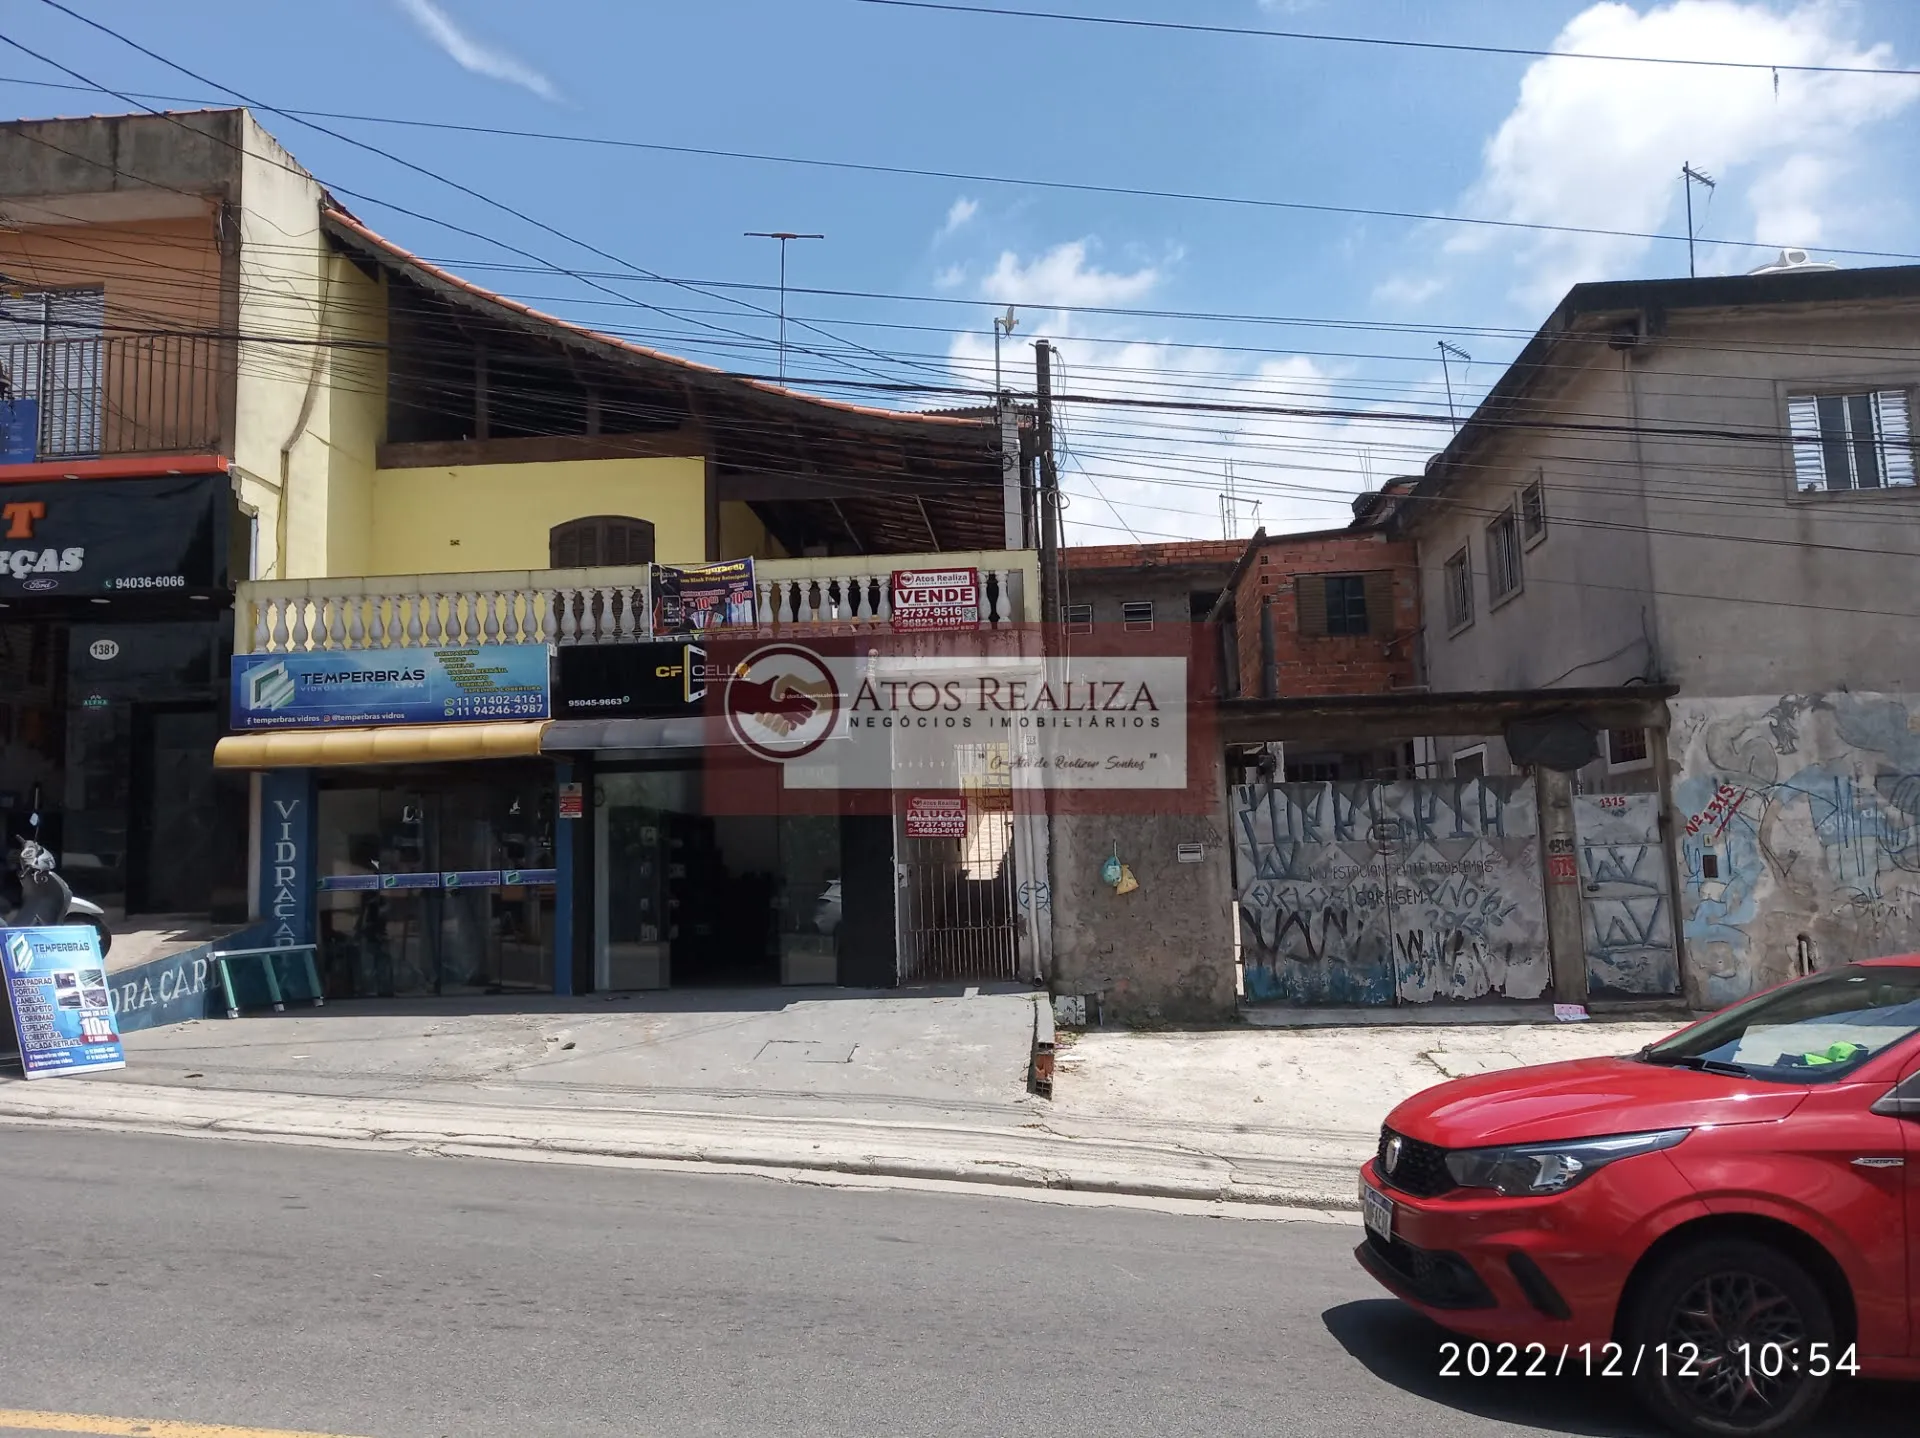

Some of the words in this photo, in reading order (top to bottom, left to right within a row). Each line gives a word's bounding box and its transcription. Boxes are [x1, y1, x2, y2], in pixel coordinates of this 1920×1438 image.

[115, 576, 185, 589] 94036-6066
[915, 575, 935, 583] Atos
[937, 574, 968, 582] Realiza
[26, 579, 55, 589] Ford
[898, 588, 973, 604] VENDE
[902, 607, 962, 618] 2737-9516
[902, 617, 962, 627] 96823-0187
[92, 644, 115, 656] 1381
[300, 666, 426, 685] TEMPERBRÁS
[655, 665, 683, 678] CF
[457, 697, 470, 706] 11
[473, 694, 543, 705] 91402-4161
[568, 698, 623, 707] 95045-9663
[457, 707, 470, 716] 11
[473, 704, 543, 715] 94246-2987
[253, 715, 296, 725] temperbras
[297, 714, 320, 722] vidros
[381, 711, 405, 720] vidros
[909, 810, 964, 818] ALUGA
[33, 940, 90, 952] TEMPERBRÁS
[14, 987, 39, 995] PORTAS
[16, 995, 45, 1005] JANELAS
[18, 1005, 53, 1014] PARAPEITO
[22, 1024, 53, 1032] ESPELHOS
[24, 1032, 62, 1041] COBERTURA
[26, 1042, 52, 1051] SACADA
